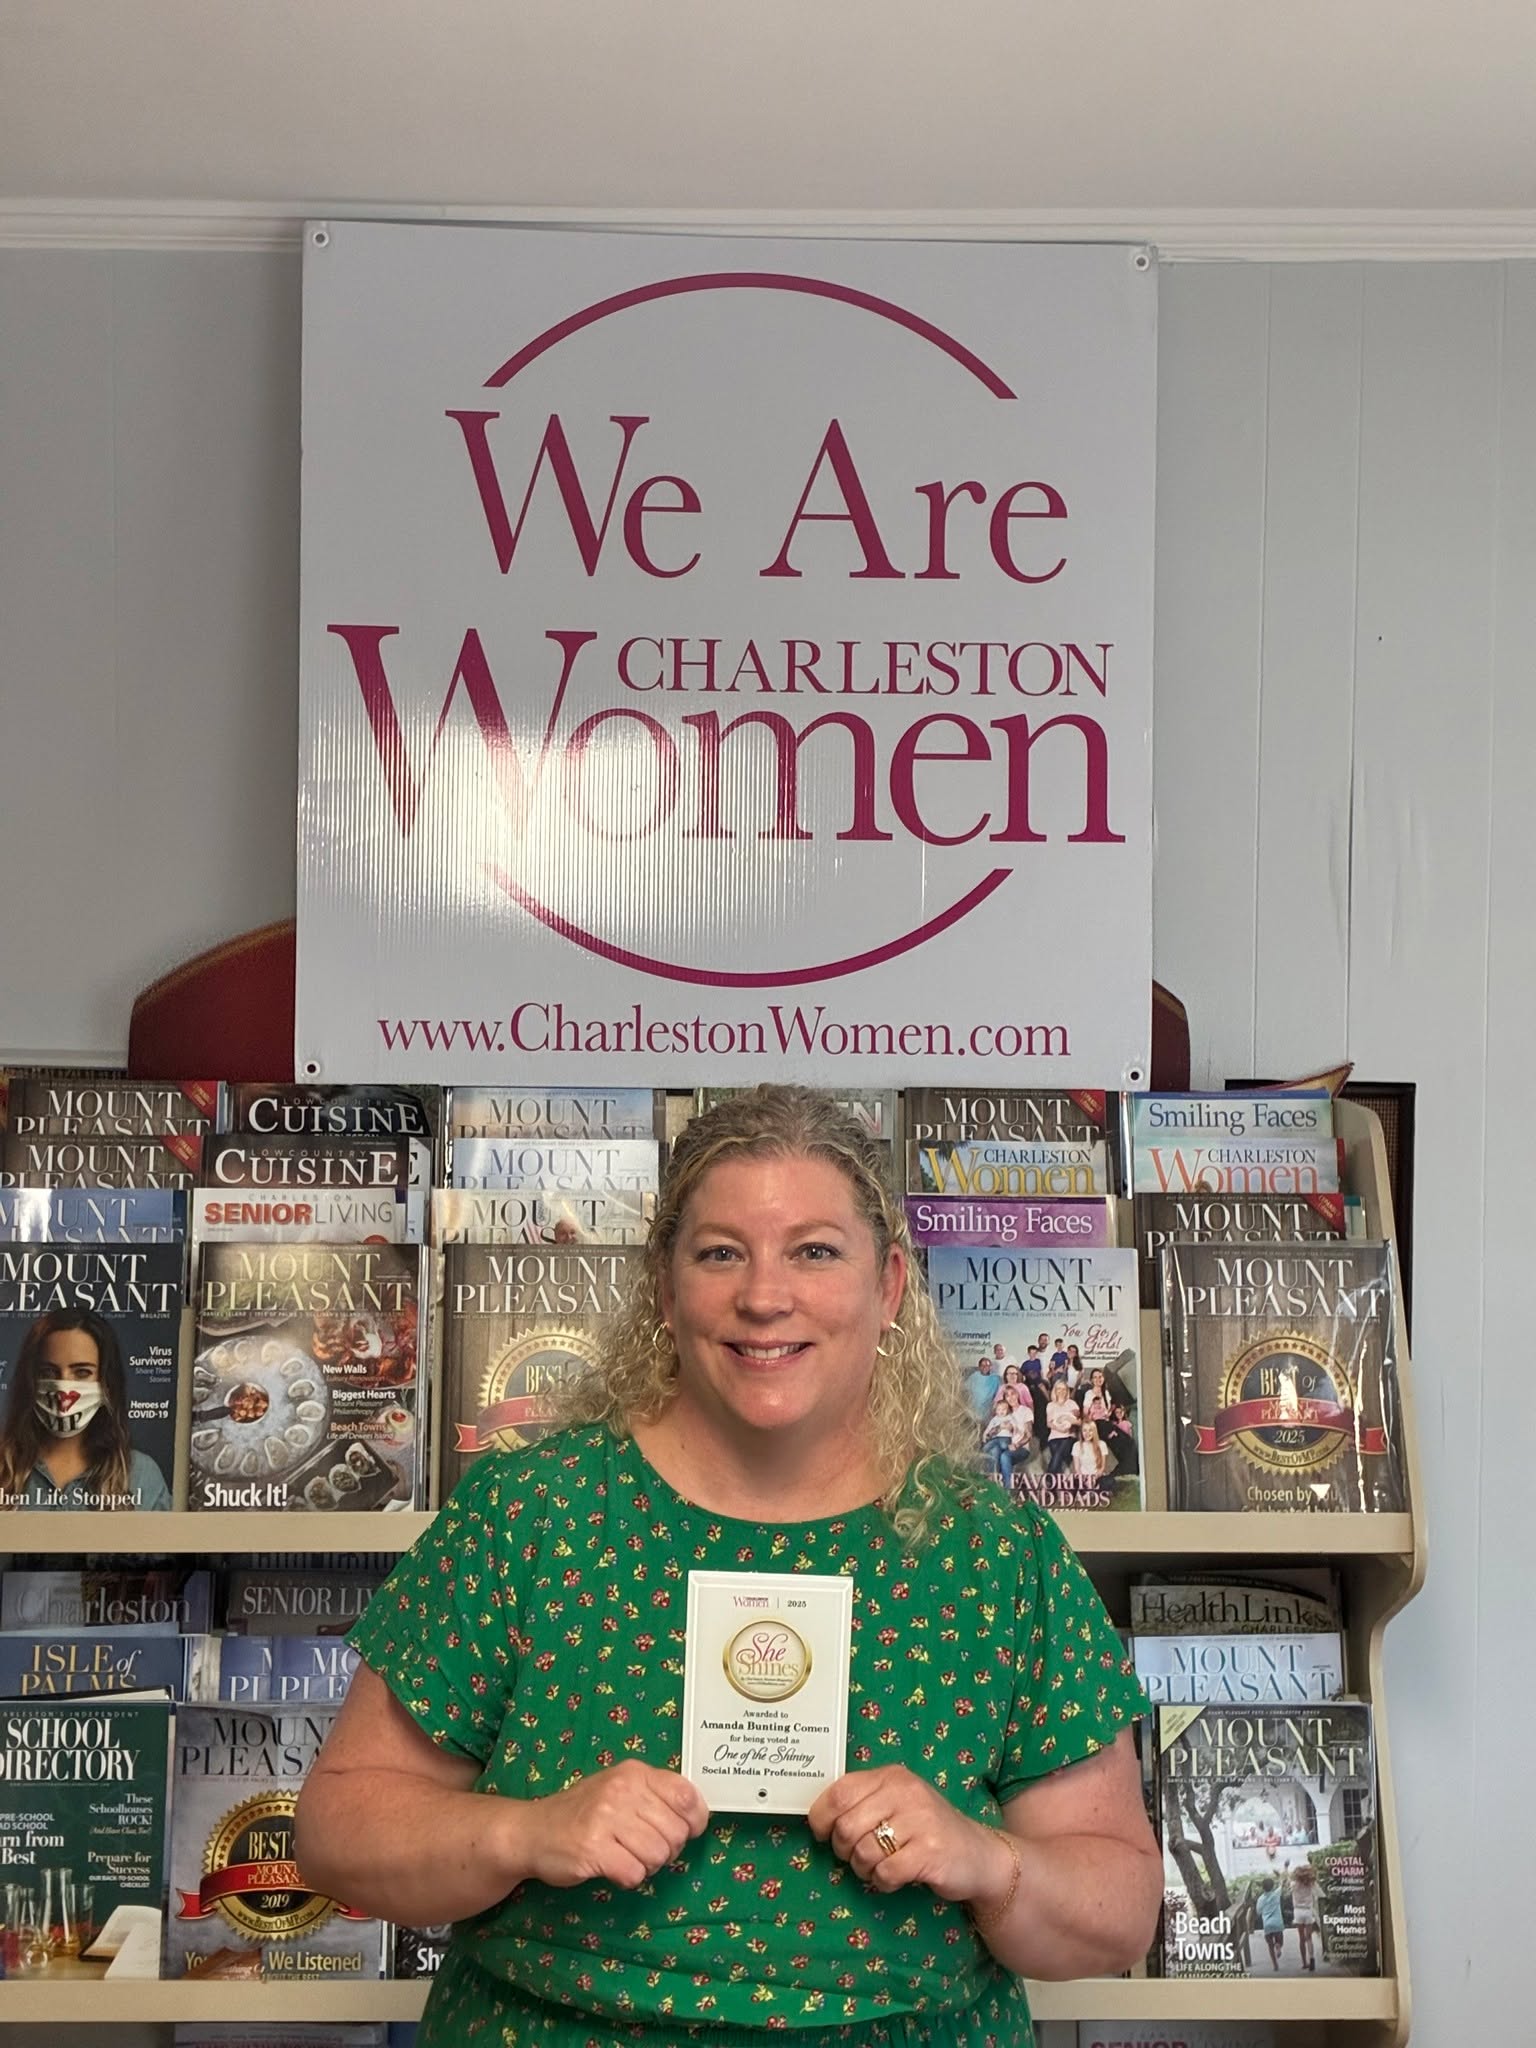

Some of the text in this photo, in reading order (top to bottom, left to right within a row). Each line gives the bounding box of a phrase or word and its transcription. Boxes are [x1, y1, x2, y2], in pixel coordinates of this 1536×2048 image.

[445, 409, 1068, 584] We Are
[617, 636, 1114, 698] CHARLESTON
[326, 624, 1126, 846] Women
[376, 1001, 1071, 1059] www.CharlestonWomen.com
[47, 1089, 182, 1119] MOUNT
[248, 1098, 424, 1134] CUISINE
[487, 1098, 616, 1125] MOUNT
[942, 1097, 1070, 1125] MOUNT
[1149, 1101, 1317, 1136] Smiling Faces
[26, 1144, 165, 1173] MOUNT
[215, 1148, 399, 1185] CUISINE
[489, 1148, 620, 1176] MOUNT
[984, 1149, 1091, 1164] CHARLESTON
[1207, 1149, 1316, 1164] CHARLESTON
[925, 1147, 1098, 1195] Women
[1147, 1148, 1318, 1193] Women
[0, 1198, 136, 1227] MUNT
[917, 1205, 1092, 1241] Smiling Faces
[1174, 1203, 1308, 1231] MOUNT
[2, 1252, 147, 1283] MOUNT
[238, 1252, 381, 1282] MOUNT
[485, 1255, 626, 1285] MOUNT
[965, 1257, 1092, 1285] MOUNT
[1213, 1258, 1354, 1287] MOUNT
[203, 1281, 412, 1312] PLEASANT
[453, 1284, 624, 1314] PLEASAN
[939, 1284, 1122, 1311] PLEASANT
[1185, 1286, 1386, 1318] PLEASANT
[1061, 1322, 1081, 1337] You
[149, 1346, 172, 1356] Virus
[1084, 1331, 1122, 1353] Girls!
[129, 1356, 172, 1366] Survivors
[322, 1364, 367, 1374] New Walls
[1260, 1366, 1299, 1396] BET
[130, 1400, 169, 1409] Heroes of
[332, 1389, 397, 1401] Biggest Hearts
[128, 1409, 169, 1419] COVID-19
[330, 1422, 386, 1432] Beach Towns
[1274, 1430, 1305, 1444] 2025
[1010, 1472, 1100, 1490] FAVORITE
[0, 1487, 143, 1511] hen Life Stopped
[203, 1482, 288, 1507] Shuck It!
[1060, 1490, 1111, 1508] DADS
[1247, 1486, 1312, 1505] Chosen by
[242, 1587, 332, 1616] SENIOR
[787, 1600, 807, 1608] 2025
[736, 1632, 789, 1665] She
[1172, 1644, 1303, 1674] MOUNT
[32, 1644, 142, 1679] ISLE of
[1145, 1673, 1335, 1702] PLEASANT
[743, 1710, 778, 1718] Awarded
[6, 1717, 120, 1749] SCHOOL
[212, 1717, 336, 1747] MOUN
[700, 1720, 830, 1733] Amanda Bunting Comen
[1199, 1718, 1332, 1748] MOUNT
[729, 1734, 741, 1742] for
[743, 1735, 765, 1745] being
[767, 1736, 789, 1744] voted
[714, 1744, 815, 1768] One of the Shining
[1168, 1747, 1363, 1778] PLEASANT
[701, 1766, 825, 1778] Social Media Professionals
[88, 1803, 153, 1814] Schoolhouses
[124, 1793, 153, 1803] These
[0, 1813, 55, 1822] PRE-SCHOOL
[12, 1822, 48, 1830] SCHOOL
[118, 1814, 152, 1825] ROCK!
[26, 1831, 65, 1847] from
[248, 1831, 291, 1860] BEST
[2, 1848, 37, 1865] Best
[87, 1851, 152, 1866] Prepare for
[108, 1863, 151, 1874] Success
[1324, 1856, 1364, 1866] COASTAL
[247, 1873, 300, 1885] PLEASAN
[1331, 1866, 1365, 1876] CHARM
[260, 1894, 290, 1908] 2019
[1344, 1905, 1366, 1914] Most
[1174, 1910, 1231, 1935] Beach
[1323, 1915, 1366, 1926] Expensive
[1336, 1925, 1367, 1935] Homes
[1175, 1937, 1235, 1961] Towns
[268, 1951, 293, 1971] We
[297, 1951, 361, 1972] Listened
[1175, 1962, 1242, 1972] LIFE ALONG THE
